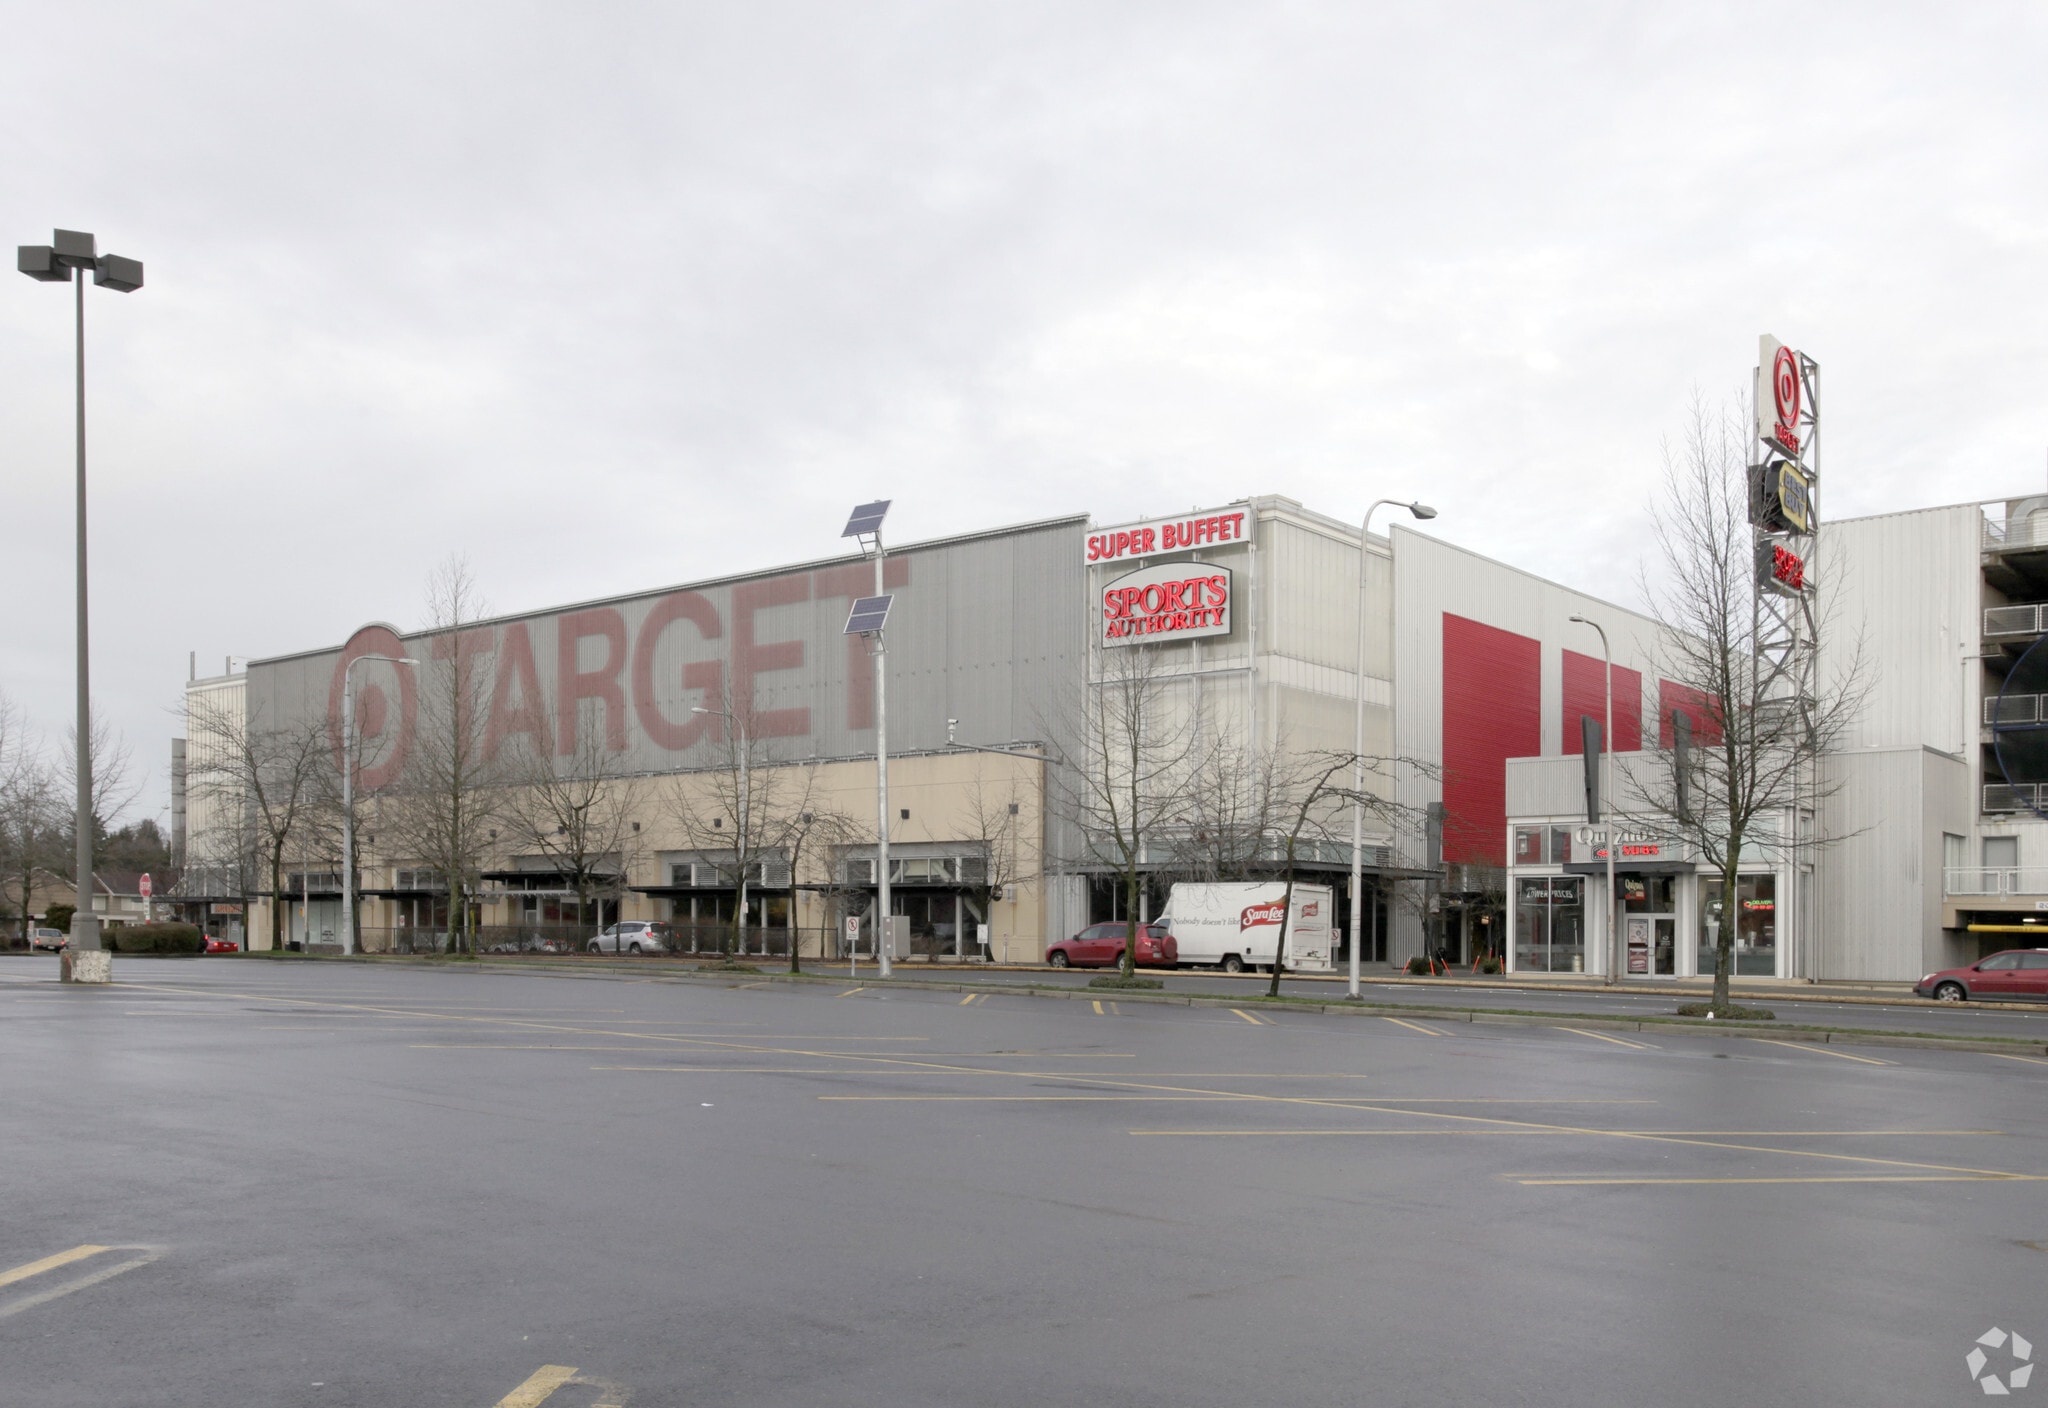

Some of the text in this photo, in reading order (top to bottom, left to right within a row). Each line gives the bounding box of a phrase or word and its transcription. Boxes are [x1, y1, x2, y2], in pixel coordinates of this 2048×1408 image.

[1774, 421, 1800, 455] TARGET
[1784, 470, 1807, 502] BEST
[1784, 489, 1805, 518] BUY
[1087, 512, 1244, 560] SUPER BUFFET
[1104, 575, 1227, 620] SPORTS
[1105, 607, 1225, 638] AUTHORITY
[431, 557, 909, 759] TARGET
[1622, 844, 1659, 856] SUBS
[1242, 908, 1268, 926] Sara
[1267, 906, 1284, 922] Lee
